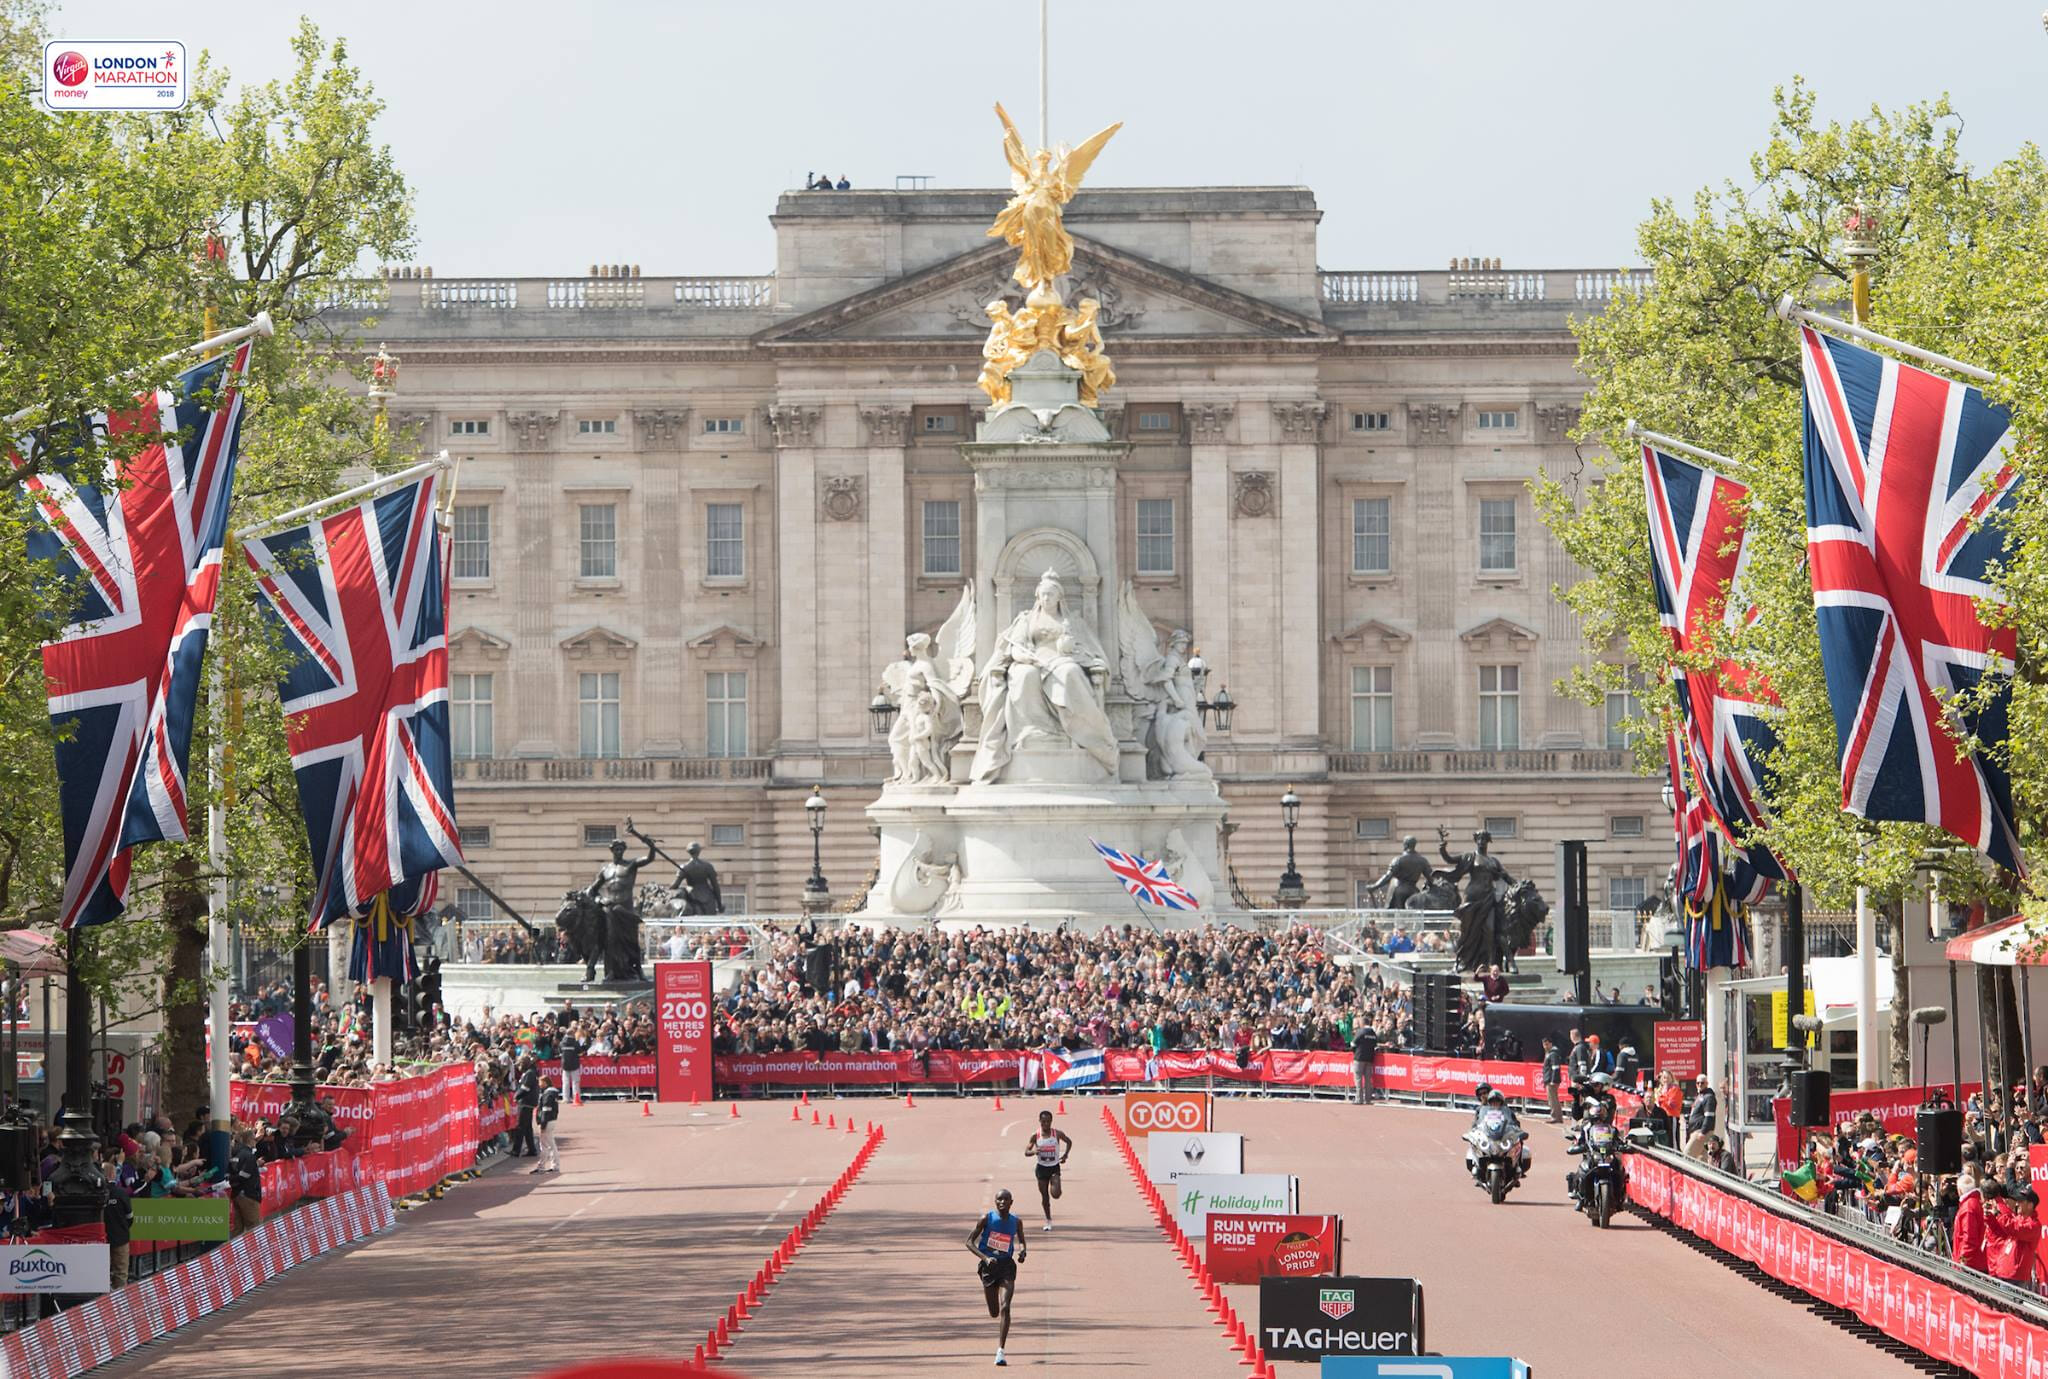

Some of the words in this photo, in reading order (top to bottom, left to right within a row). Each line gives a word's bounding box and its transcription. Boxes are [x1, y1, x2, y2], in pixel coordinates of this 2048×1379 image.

[661, 1001, 707, 1020] 200
[663, 1021, 705, 1030] METRES
[668, 1030, 682, 1039] TO
[685, 1030, 701, 1039] GO
[579, 1064, 617, 1075] london
[732, 1062, 763, 1074] virgin
[766, 1062, 805, 1073] money
[845, 1060, 897, 1071] marathon
[1308, 1060, 1329, 1076] virgin
[1487, 1073, 1525, 1086] marathon
[1133, 1105, 1198, 1124] TNT
[1209, 1195, 1260, 1211] Holiday
[1262, 1195, 1284, 1208] Inn
[134, 1215, 154, 1224] THE
[158, 1215, 190, 1225] ROYAL
[192, 1216, 224, 1224] PARKS
[1213, 1220, 1245, 1231] RUN
[1247, 1221, 1287, 1233] WITH
[1213, 1233, 1256, 1245] PRIDE
[1278, 1250, 1320, 1265] LONDON
[9, 1257, 67, 1275] Buxton
[1286, 1259, 1315, 1271] PRIDE
[1323, 1292, 1351, 1301] TAG
[1322, 1303, 1353, 1317] HEUER
